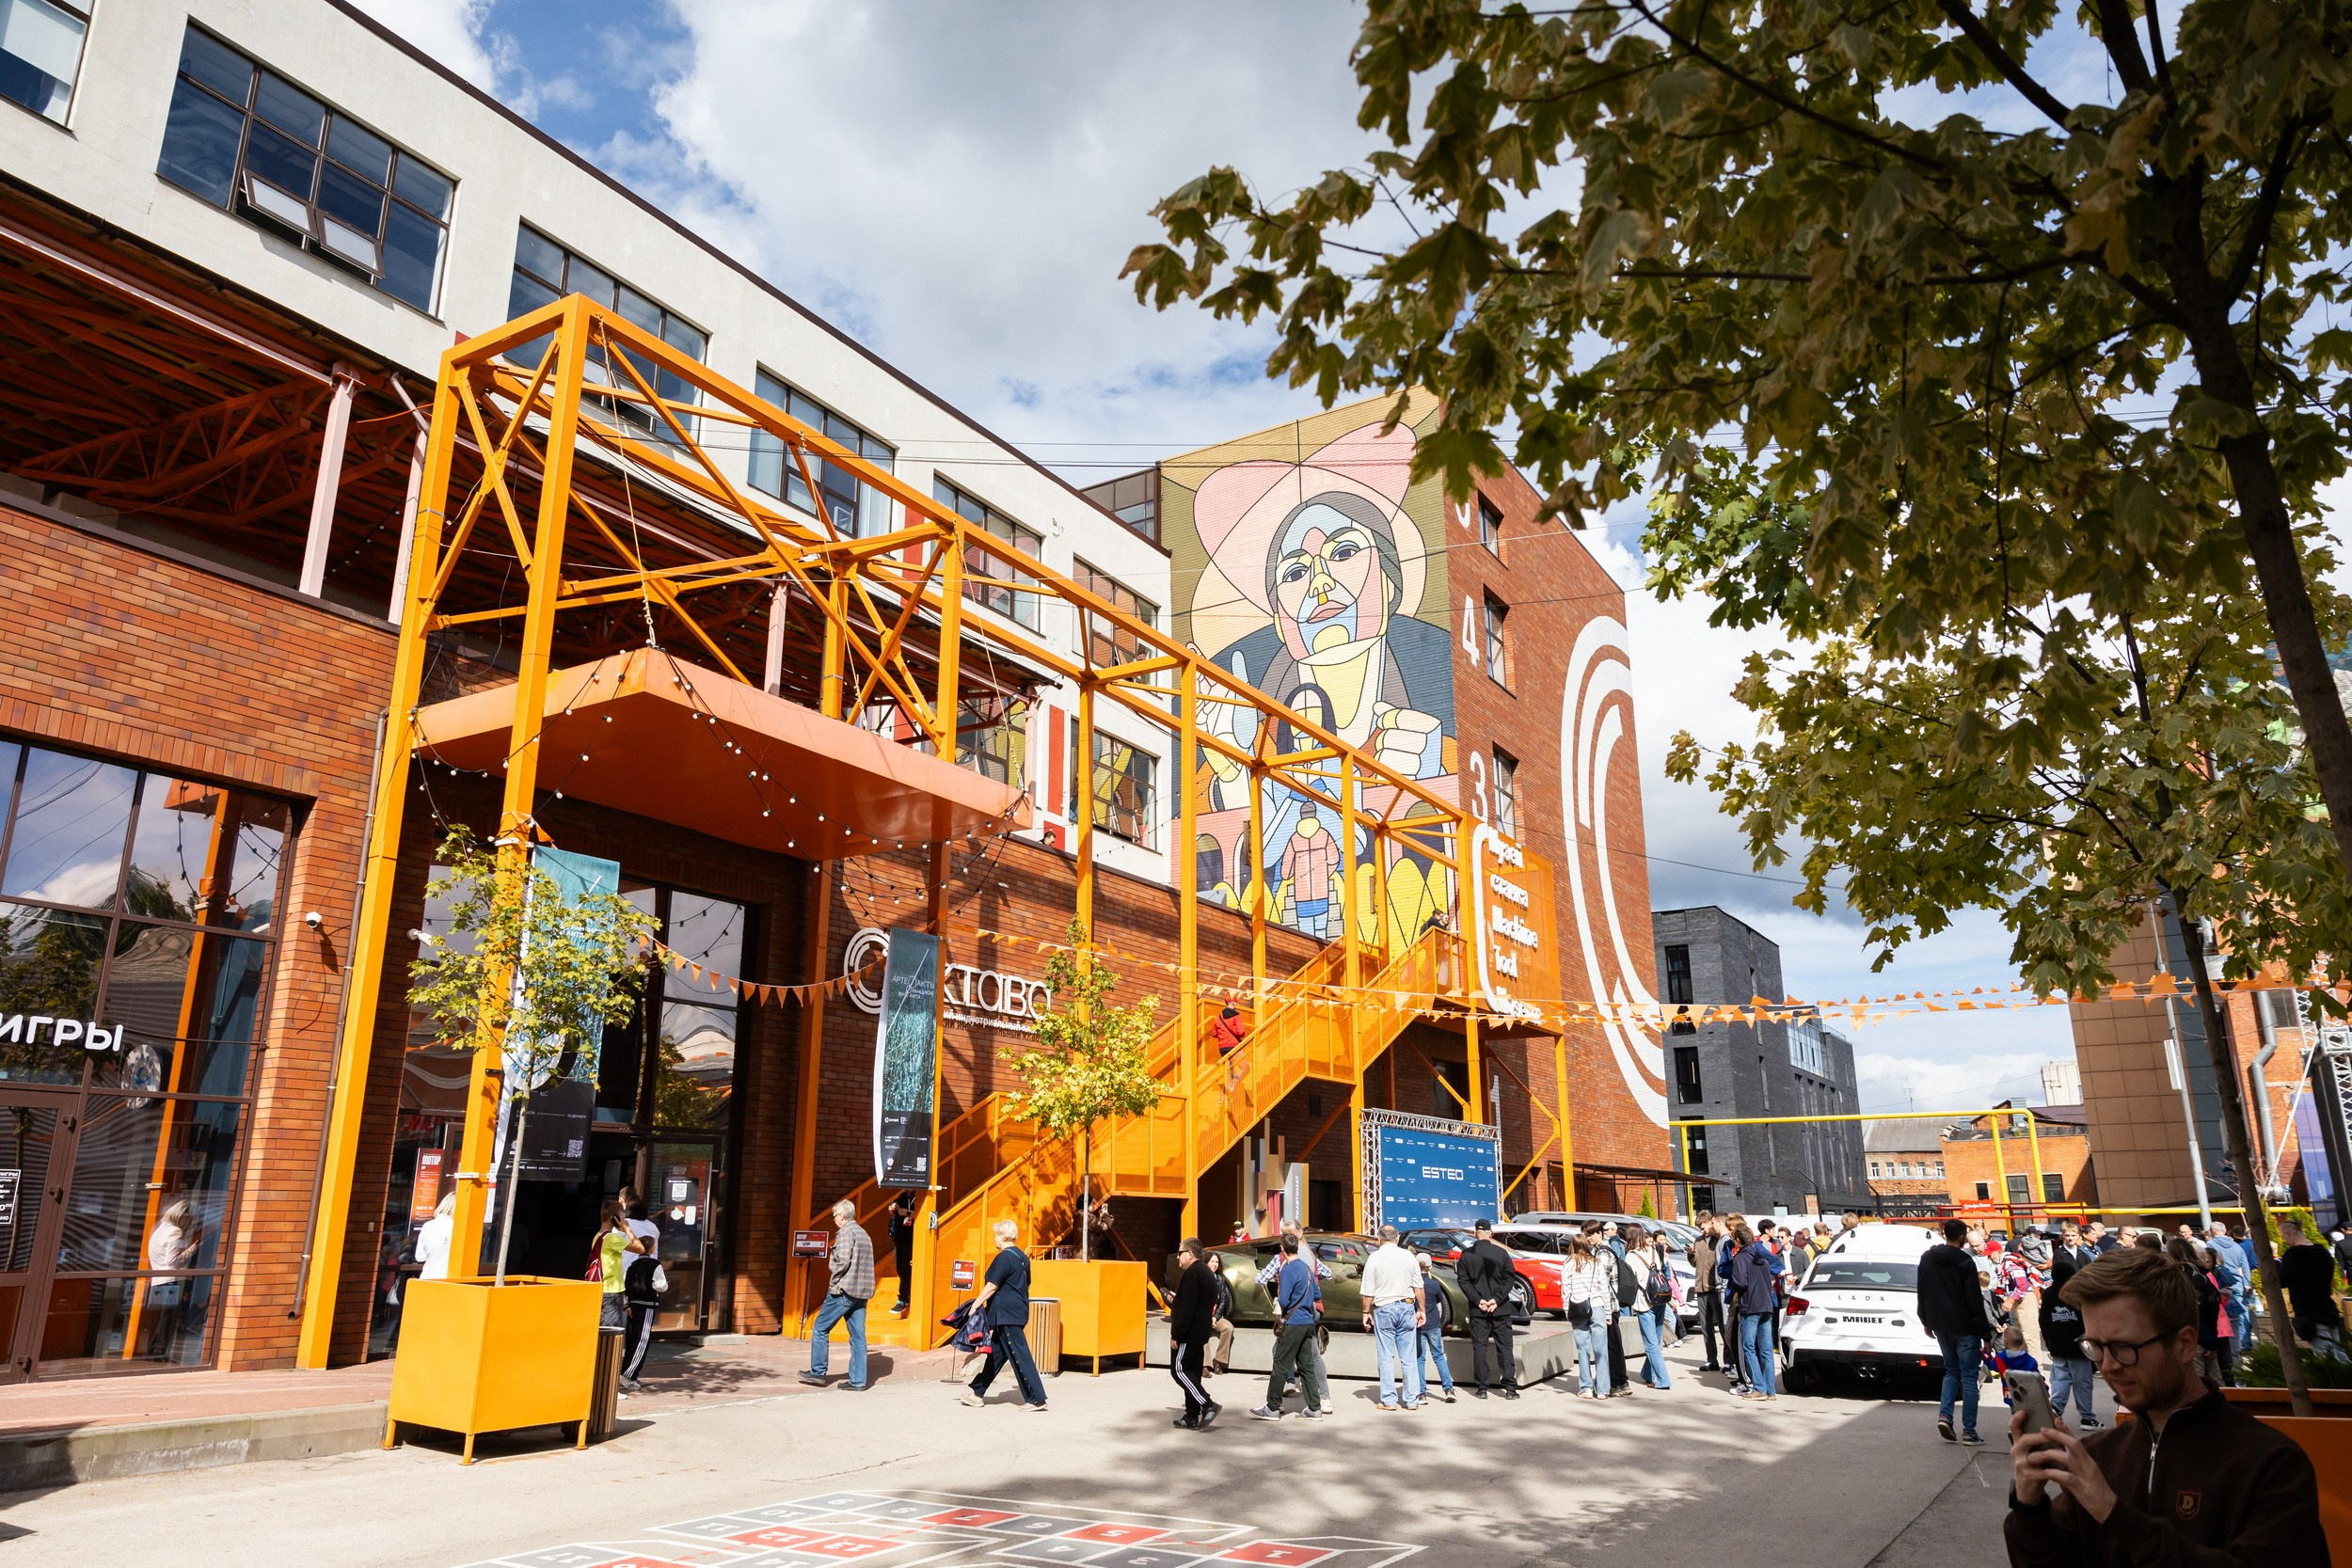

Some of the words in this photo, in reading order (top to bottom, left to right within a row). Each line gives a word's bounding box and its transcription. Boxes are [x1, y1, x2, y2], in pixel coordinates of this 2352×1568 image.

[1461, 594, 1481, 667] 4
[1470, 750, 1488, 822] 3
[1492, 904, 1538, 949] Machine
[1493, 944, 1518, 978] Tool
